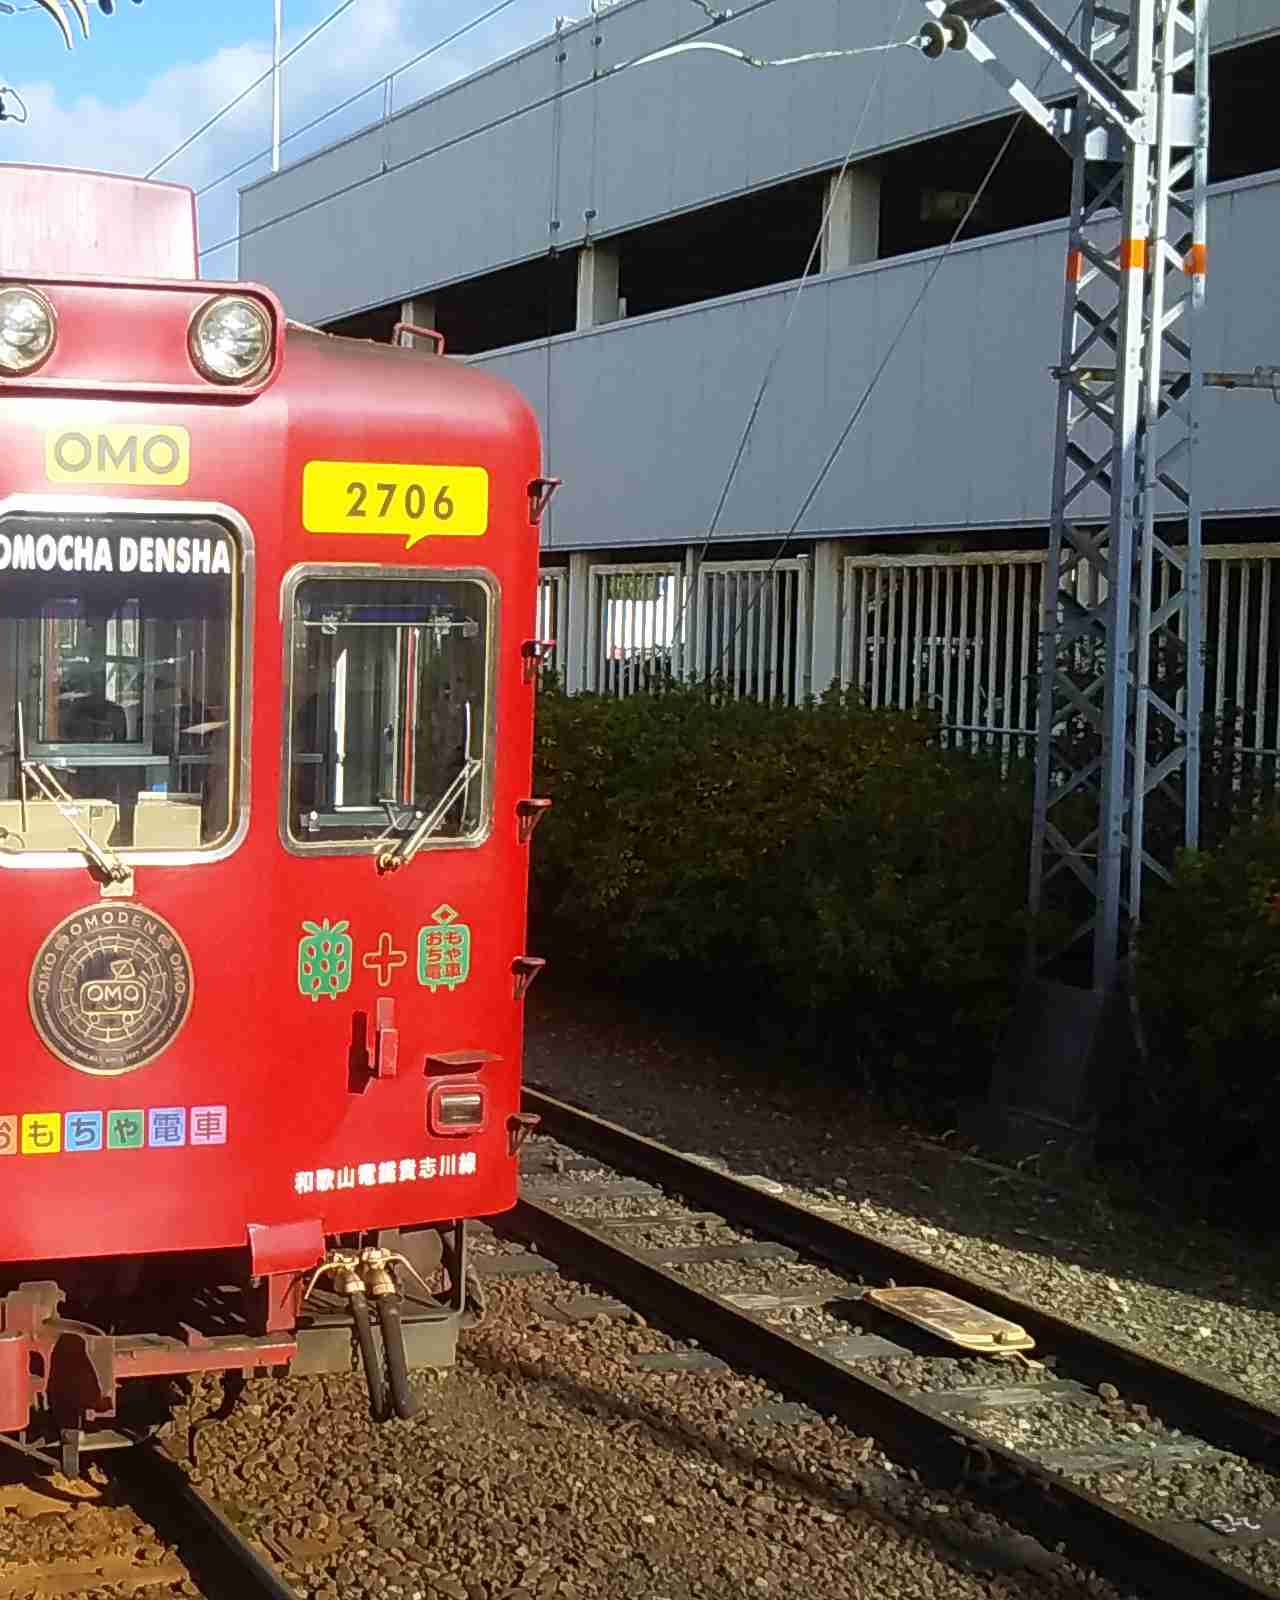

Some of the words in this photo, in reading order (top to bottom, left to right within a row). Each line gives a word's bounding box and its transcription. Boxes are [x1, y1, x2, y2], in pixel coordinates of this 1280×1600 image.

[53, 431, 180, 475] OMO
[345, 481, 455, 521] 2706
[118, 536, 231, 574] DENSHA
[70, 911, 160, 936] OMODEN
[37, 953, 57, 994] OMO
[87, 984, 140, 1002] OMO
[169, 953, 186, 994] OMO
